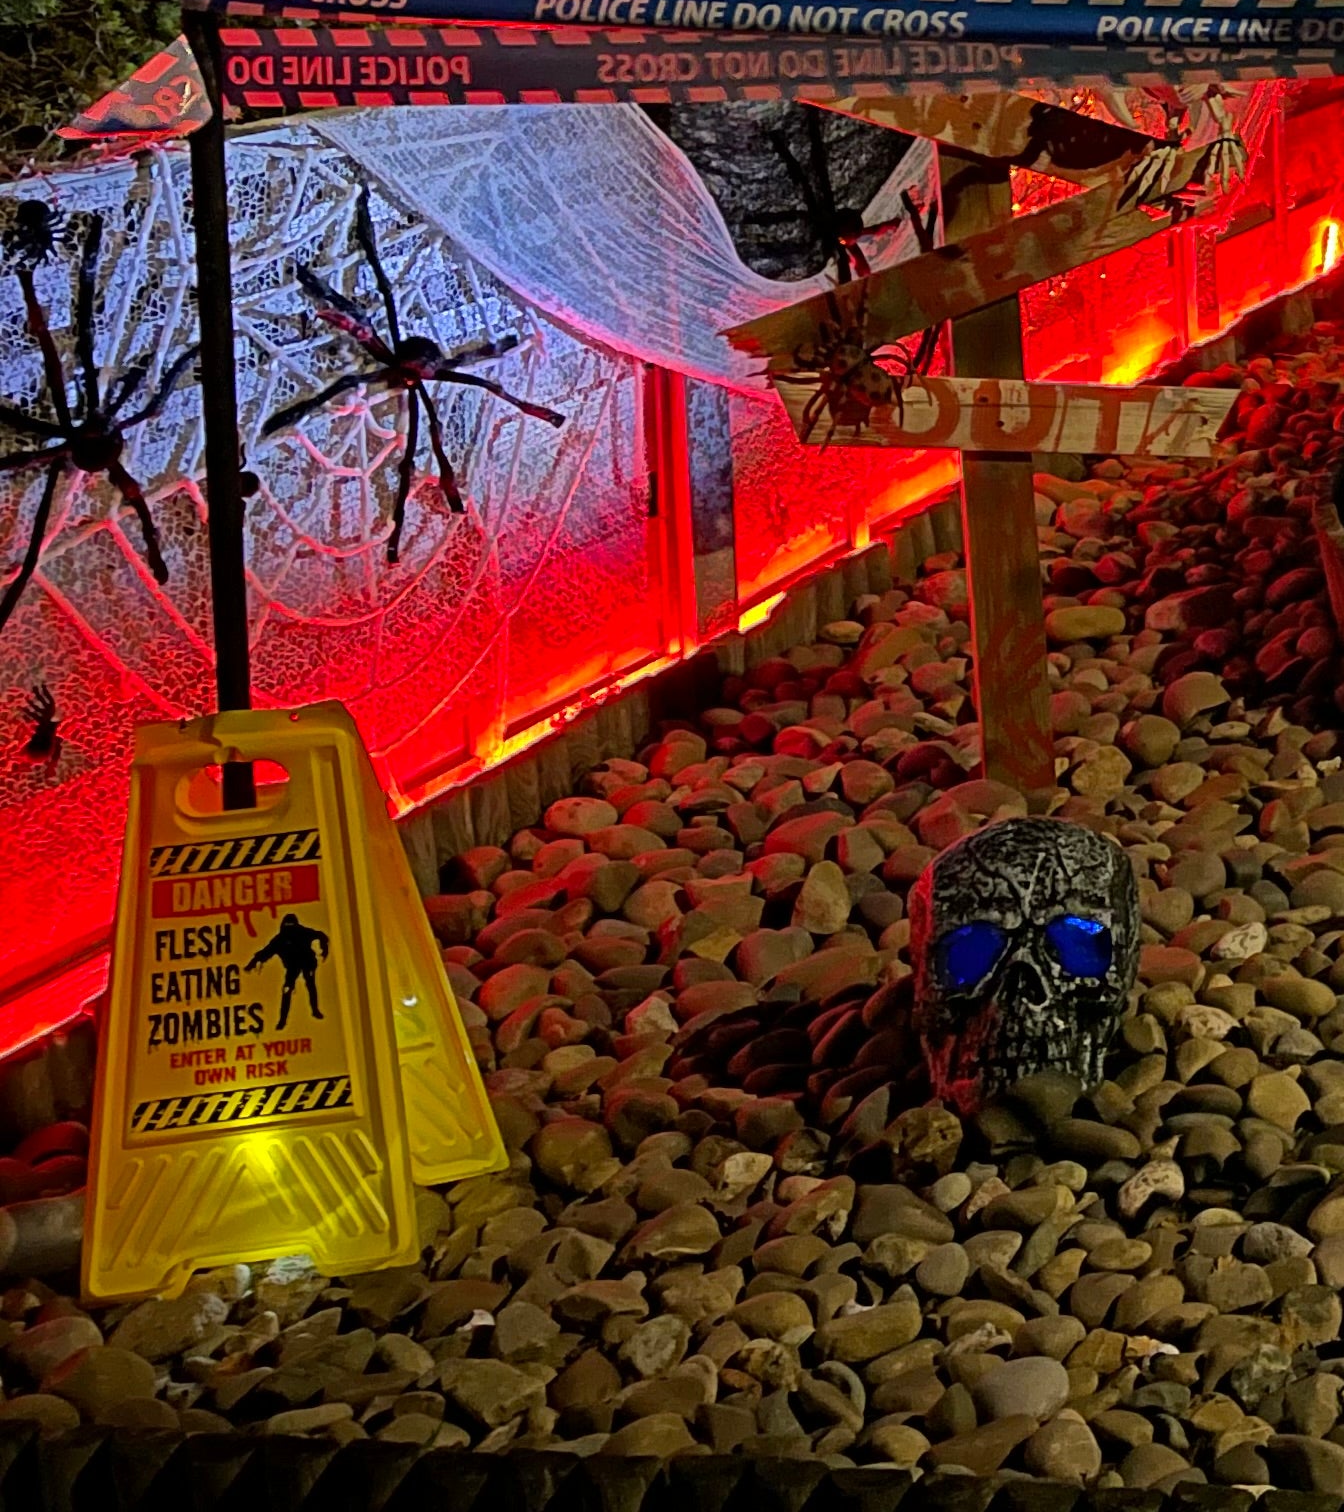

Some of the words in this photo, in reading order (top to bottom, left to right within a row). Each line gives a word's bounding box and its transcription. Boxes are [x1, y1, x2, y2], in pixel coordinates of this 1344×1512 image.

[729, 2, 783, 32] DO
[788, 5, 861, 35] NOT
[862, 7, 967, 38] CROSS
[1098, 15, 1213, 43] POLICE
[1218, 17, 1293, 43] LINE
[172, 870, 293, 913] DANGER
[155, 923, 232, 962] FLESH
[151, 963, 240, 1005] EATING
[148, 1002, 265, 1045] ZOMBIES
[170, 1047, 227, 1069] ENTER
[235, 1044, 256, 1062] AT
[264, 1038, 312, 1058] YOUR
[194, 1065, 236, 1086] OWN
[246, 1060, 289, 1079] RISK
